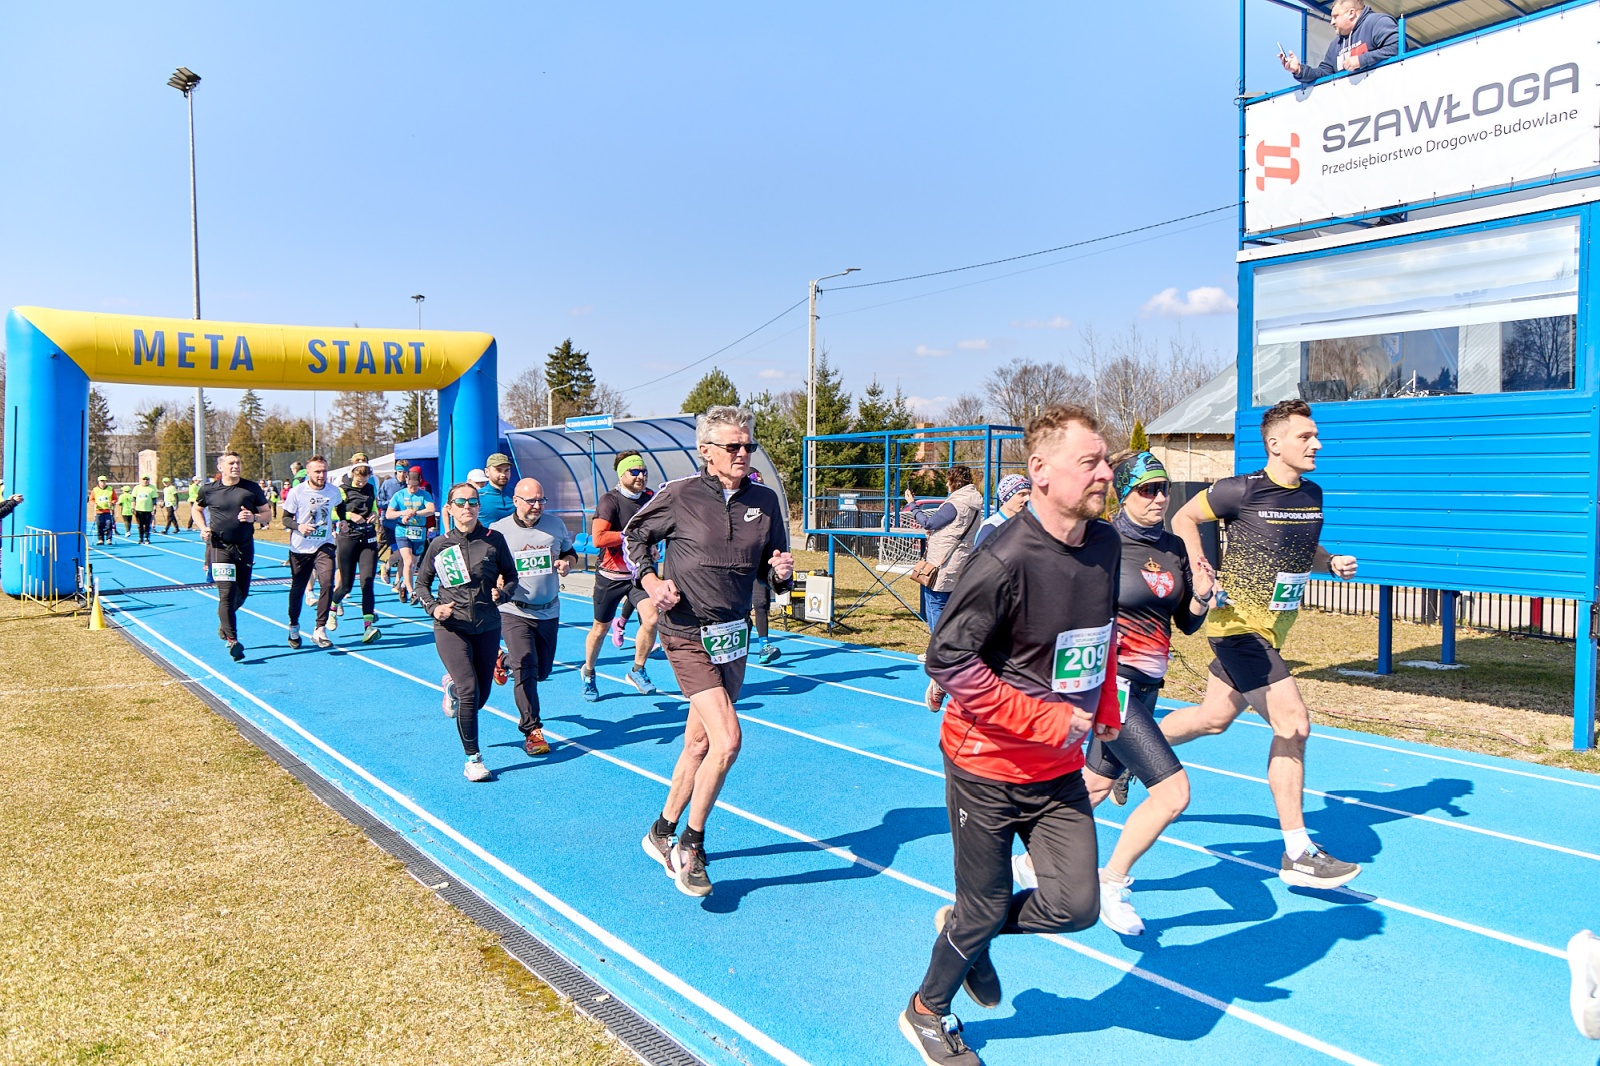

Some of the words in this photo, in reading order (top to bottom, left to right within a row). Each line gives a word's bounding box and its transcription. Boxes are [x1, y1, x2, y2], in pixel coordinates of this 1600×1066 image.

[1322, 62, 1579, 153] SZAWŁOGA
[1321, 144, 1423, 176] Przedsiębiorstwo
[1426, 109, 1579, 153] Drogowo-Budowlane
[133, 329, 254, 371] META
[307, 339, 426, 374] START
[442, 554, 460, 580] 222
[520, 556, 546, 568] 204
[710, 631, 741, 652] 226
[1064, 644, 1105, 671] 209
